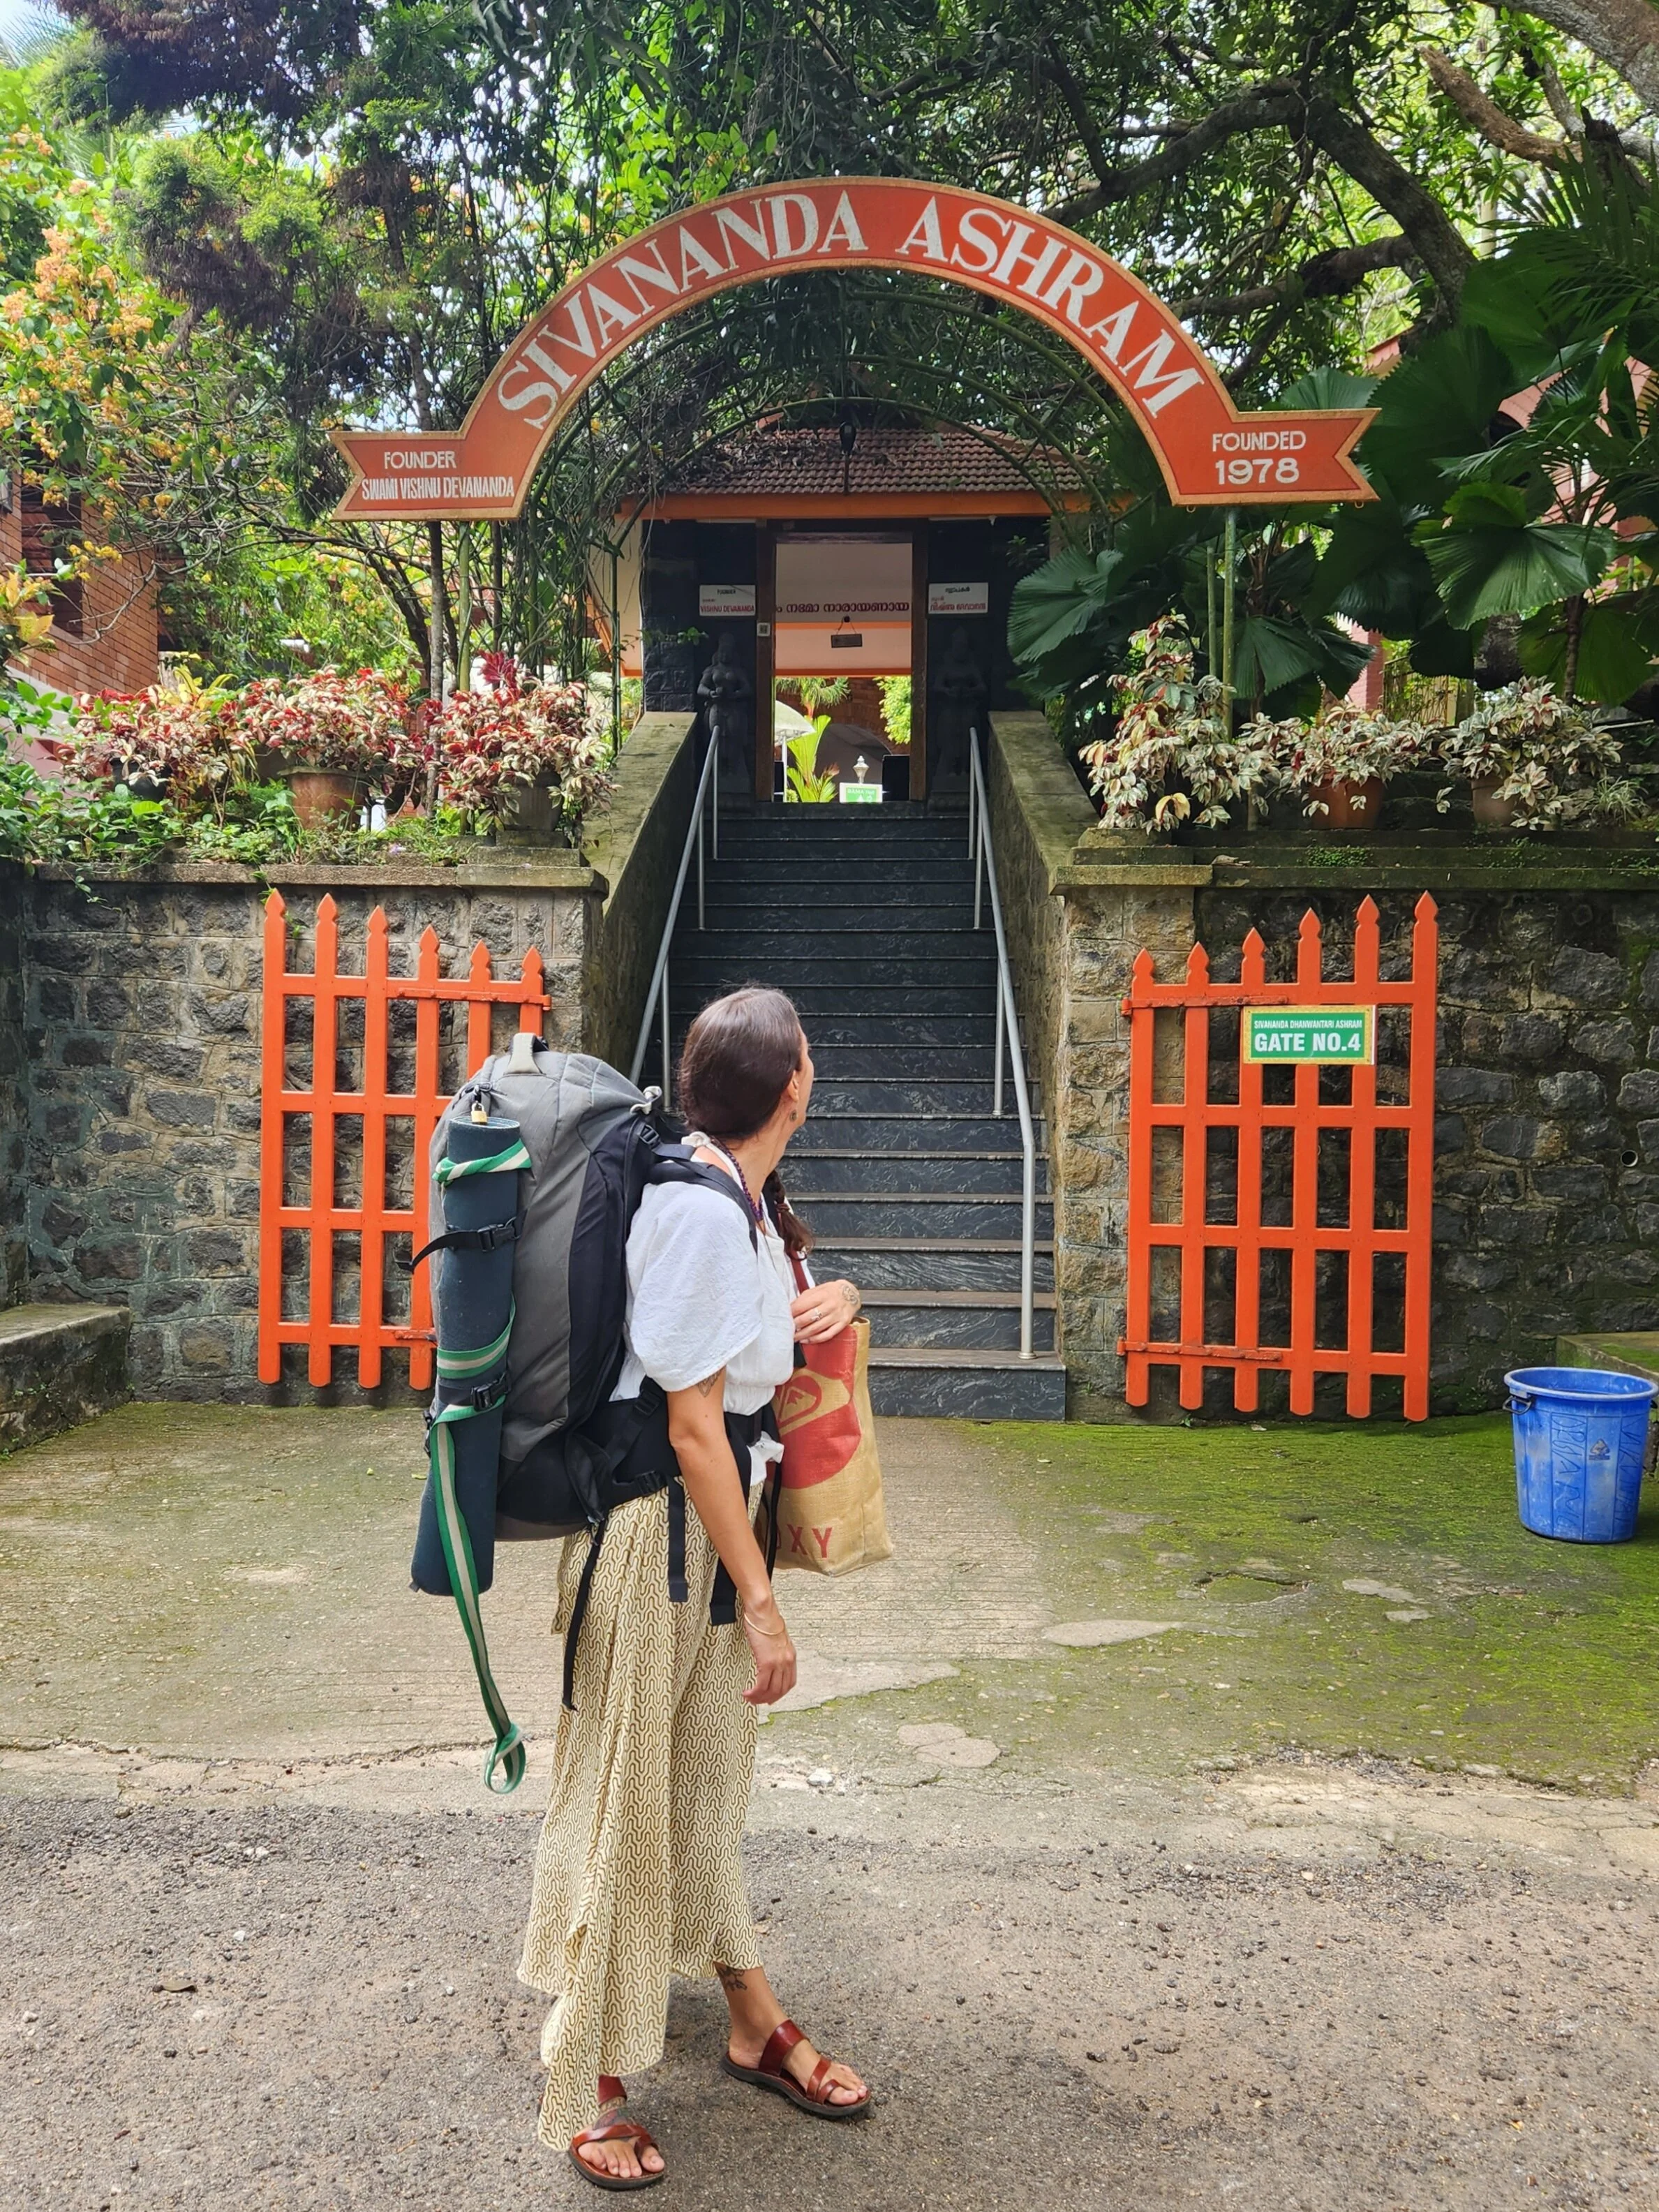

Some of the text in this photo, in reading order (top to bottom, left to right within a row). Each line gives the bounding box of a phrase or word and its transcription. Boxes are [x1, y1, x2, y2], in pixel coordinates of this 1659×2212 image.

[497, 189, 1205, 430] SIVANANDA ASHRAM
[1212, 430, 1307, 452] FOUNDED
[384, 450, 457, 470] FOUNDER
[1215, 457, 1300, 485] 1978
[362, 476, 515, 500] SWAMI VISHNU DEVANANDA
[1254, 1019, 1362, 1029] SIVANANDA DHANWANTARI ASHRAM
[1254, 1032, 1362, 1052] GATE NO.4
